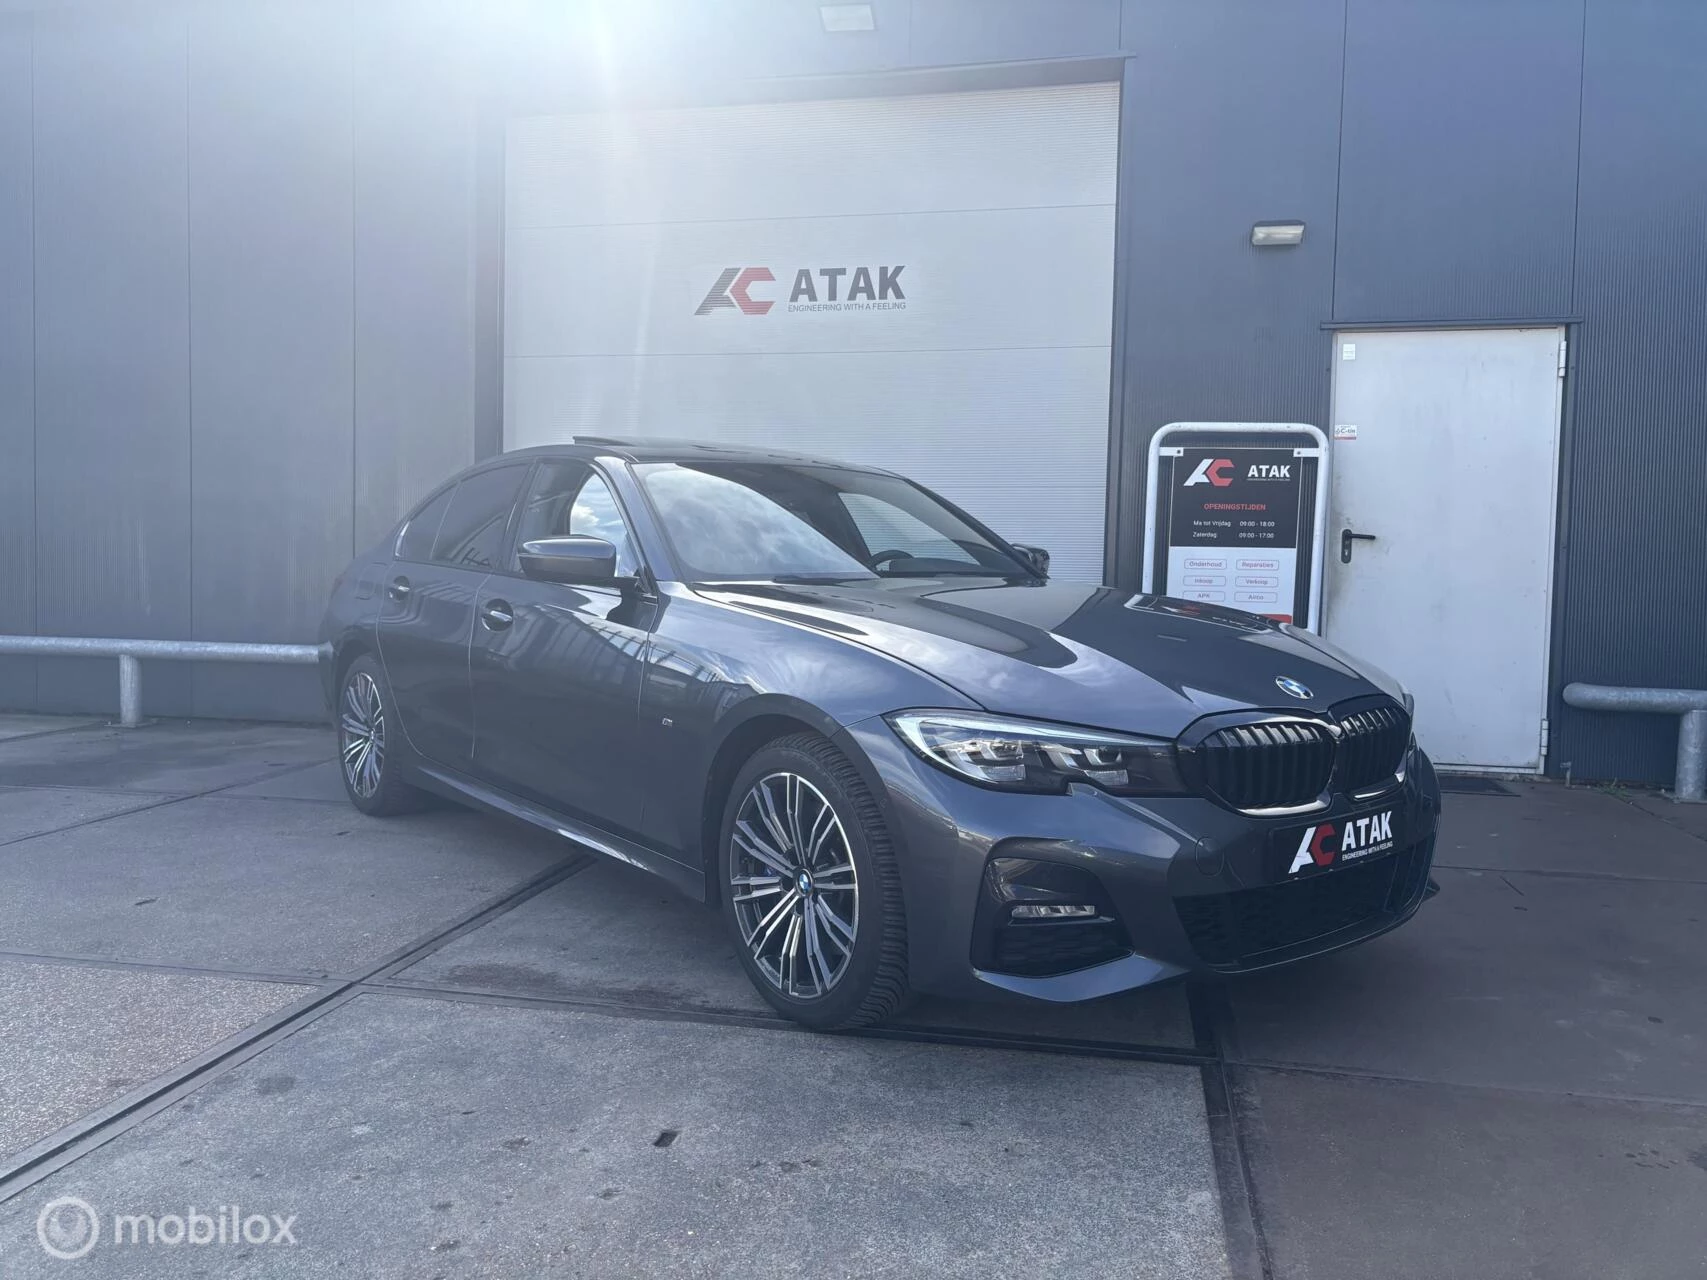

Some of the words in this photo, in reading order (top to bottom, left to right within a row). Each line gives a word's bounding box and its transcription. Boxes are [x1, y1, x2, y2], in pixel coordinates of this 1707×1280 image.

[789, 265, 906, 302] ATAK
[788, 303, 842, 312] ENGINEERING
[844, 303, 865, 311] WITH
[872, 302, 906, 310] FEELING
[1247, 465, 1291, 478] ATAK
[1203, 503, 1266, 511] OPENINGSTIJDEN
[1212, 520, 1231, 528] Vrijdag
[1341, 810, 1392, 851] ATAK
[1341, 848, 1368, 861] ENGINEERING
